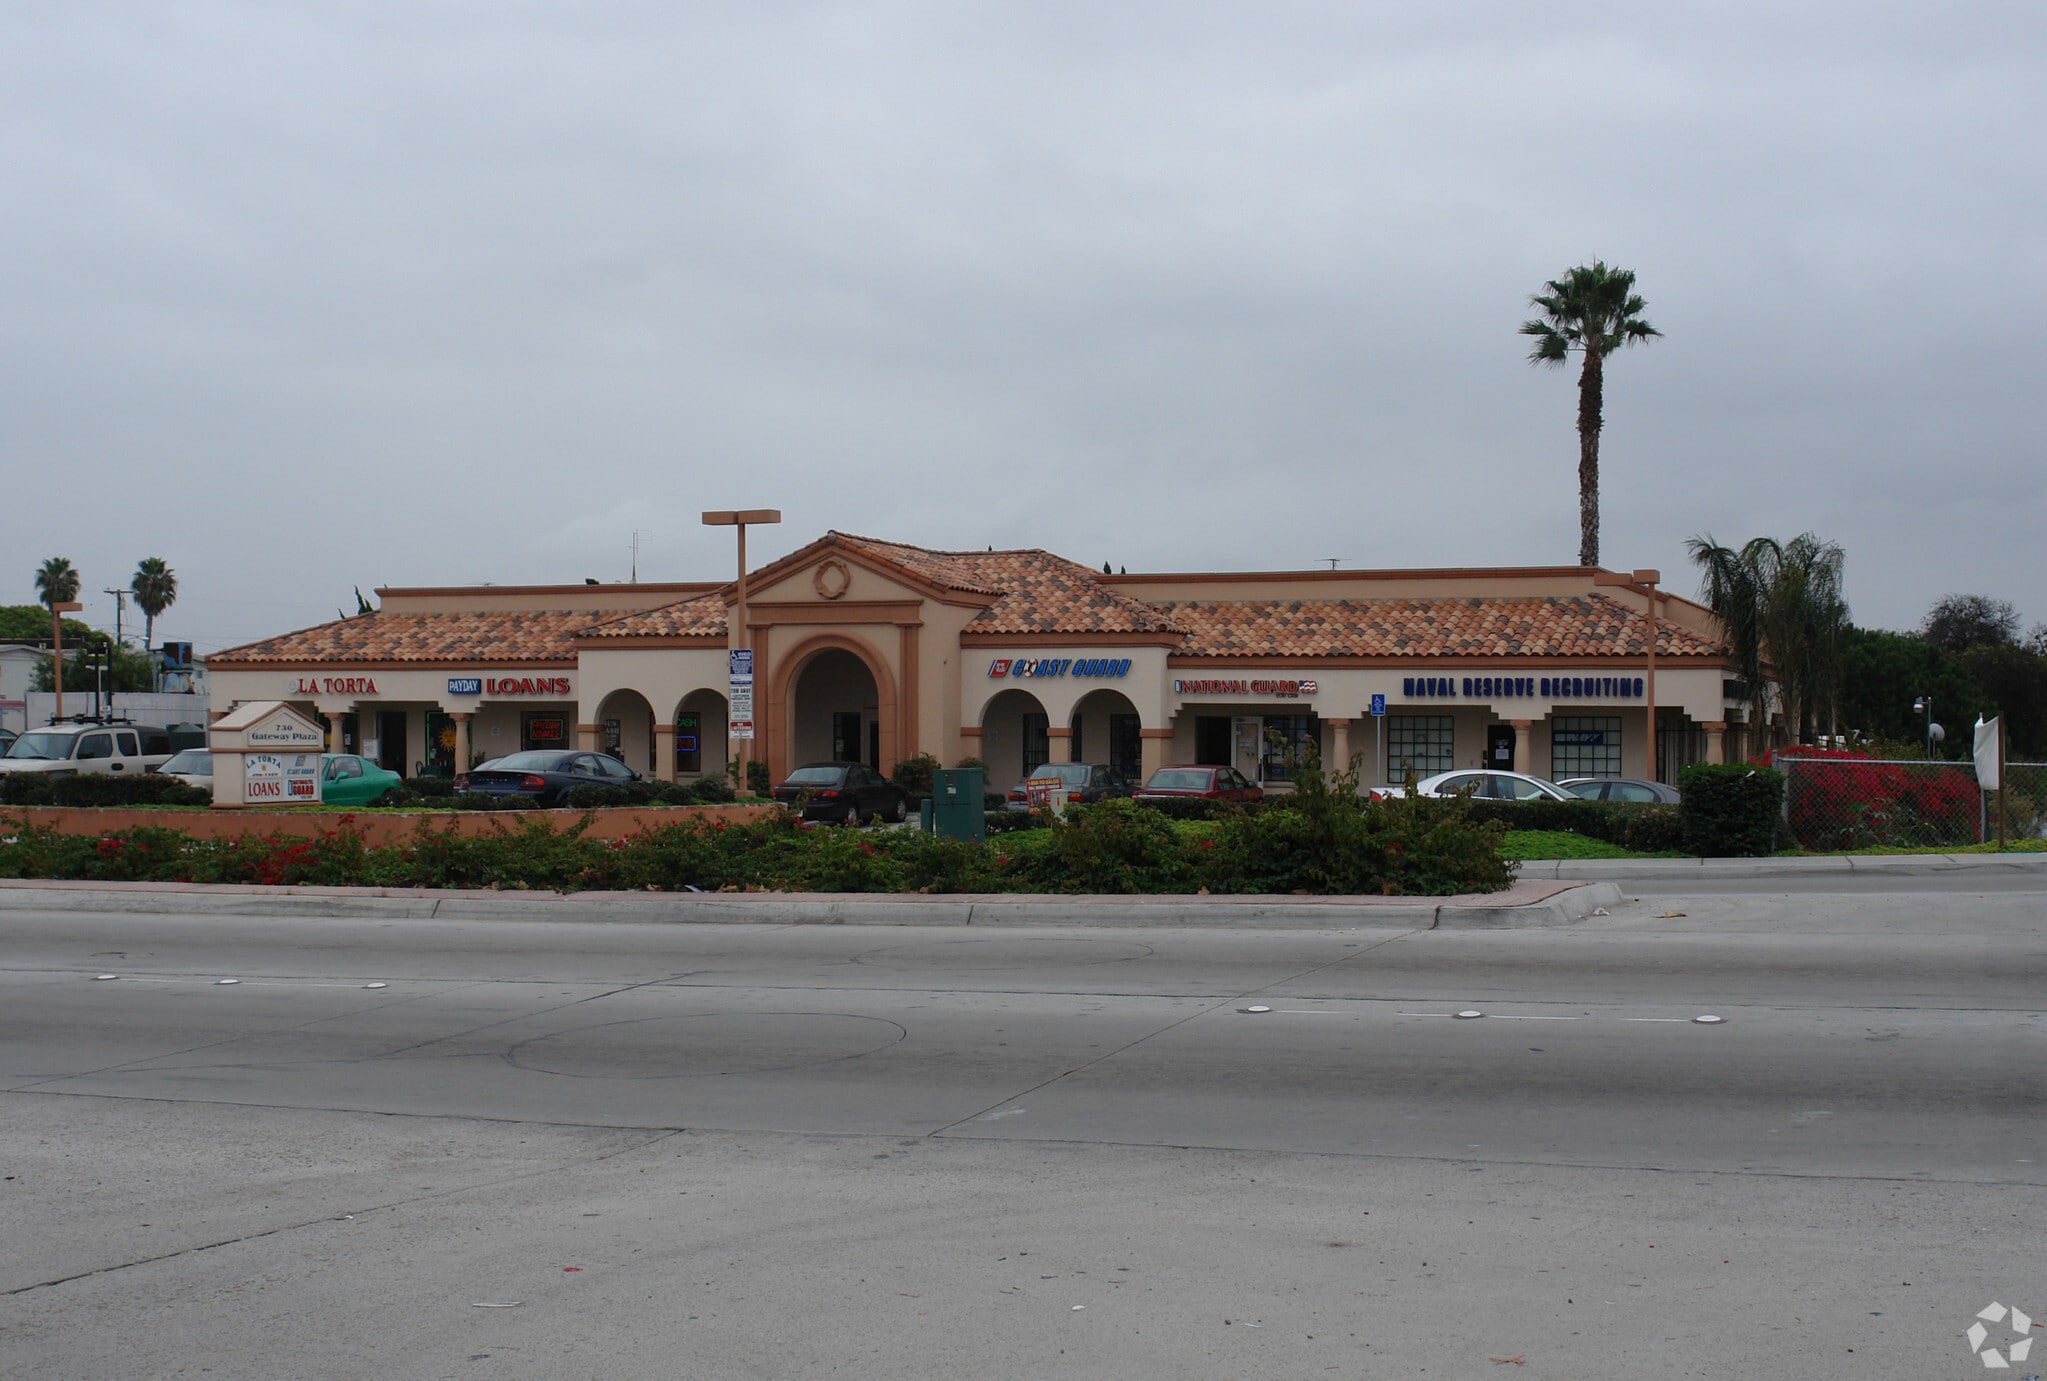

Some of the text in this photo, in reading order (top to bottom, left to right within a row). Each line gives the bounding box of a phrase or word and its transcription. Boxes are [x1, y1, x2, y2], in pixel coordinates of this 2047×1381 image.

[1012, 658, 1132, 677] COAST GUARD
[299, 677, 378, 694] LA TORTA
[449, 681, 479, 692] PAYDAY
[486, 677, 570, 695] LOANS
[1180, 679, 1299, 694] NATIONAL GUARD
[1403, 677, 1644, 697] NAVAL RESERVE RECRUITING
[252, 733, 289, 742] Gateway
[257, 755, 281, 769] TORTA
[248, 782, 280, 797] LOANS
